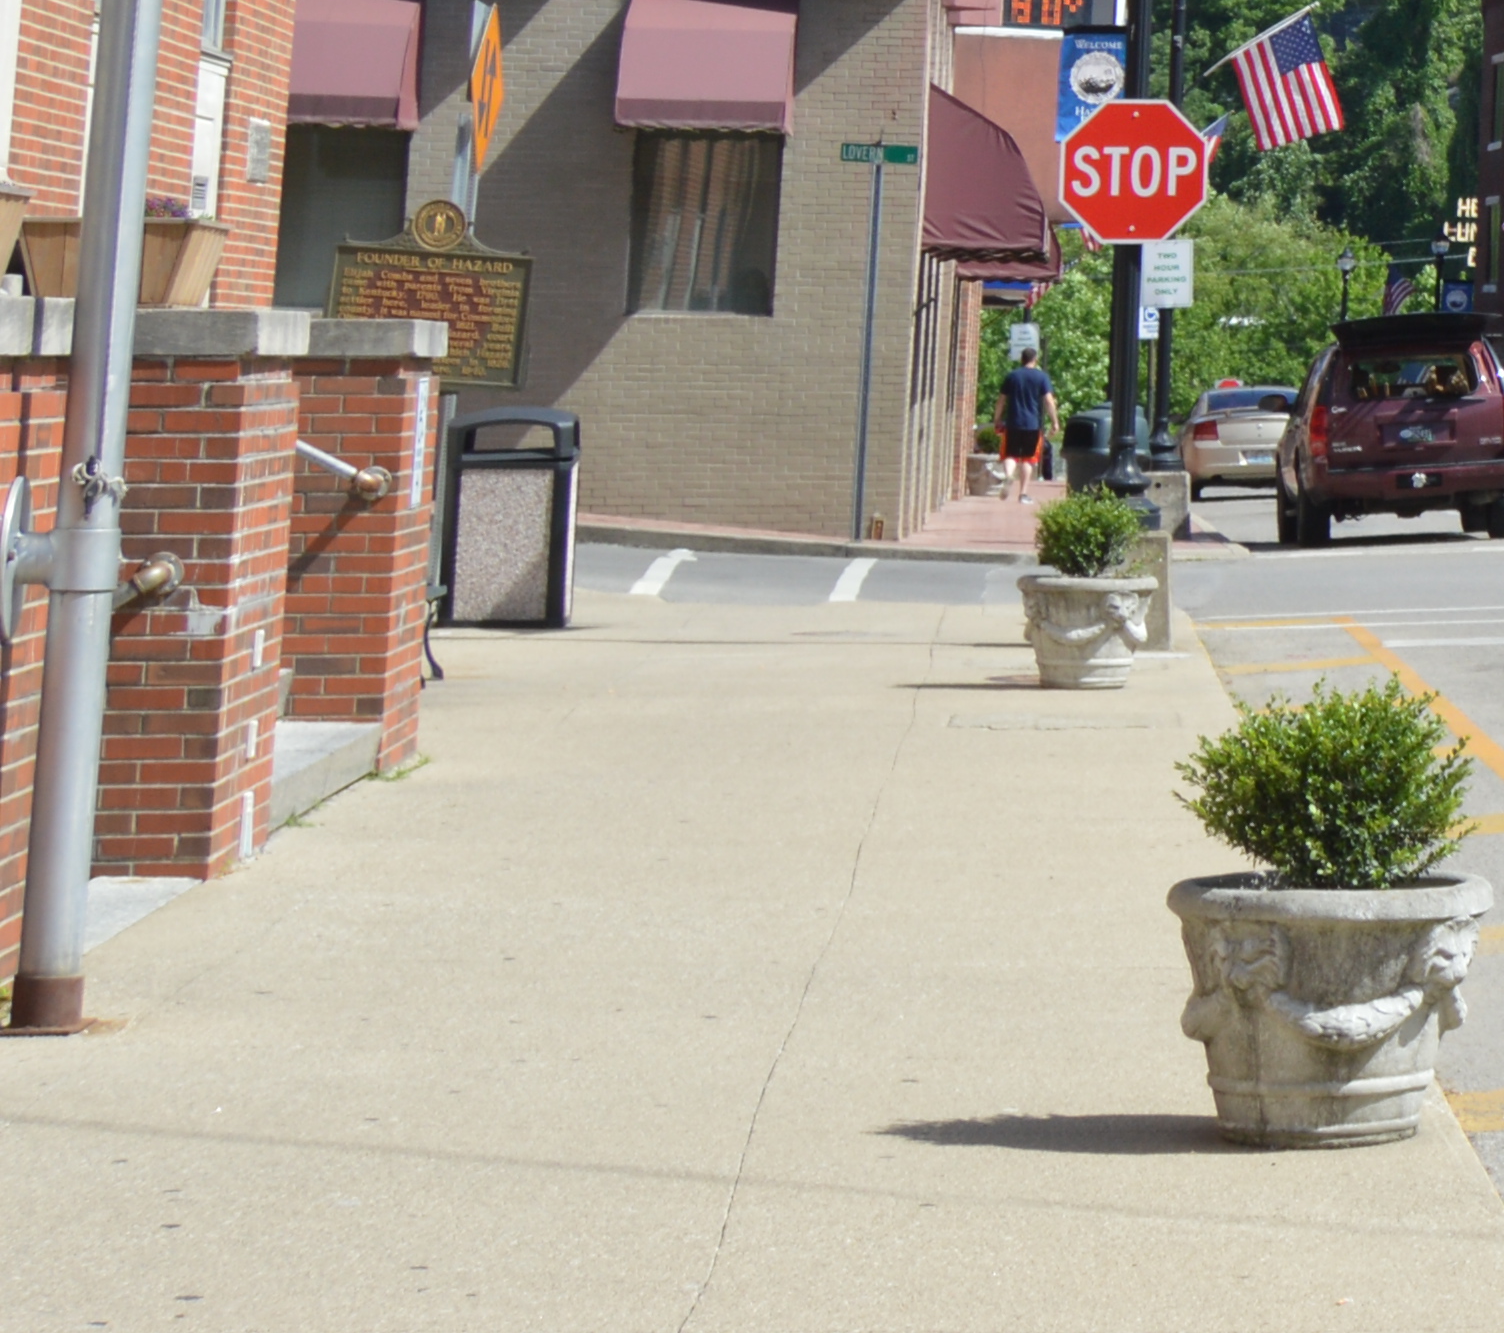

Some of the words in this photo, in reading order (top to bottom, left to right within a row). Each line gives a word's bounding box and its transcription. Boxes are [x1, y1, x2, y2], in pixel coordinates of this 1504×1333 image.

[1071, 145, 1198, 197] STOP
[357, 252, 420, 267] FOUNDER
[427, 258, 445, 269] OF
[452, 258, 513, 273] HAZARD
